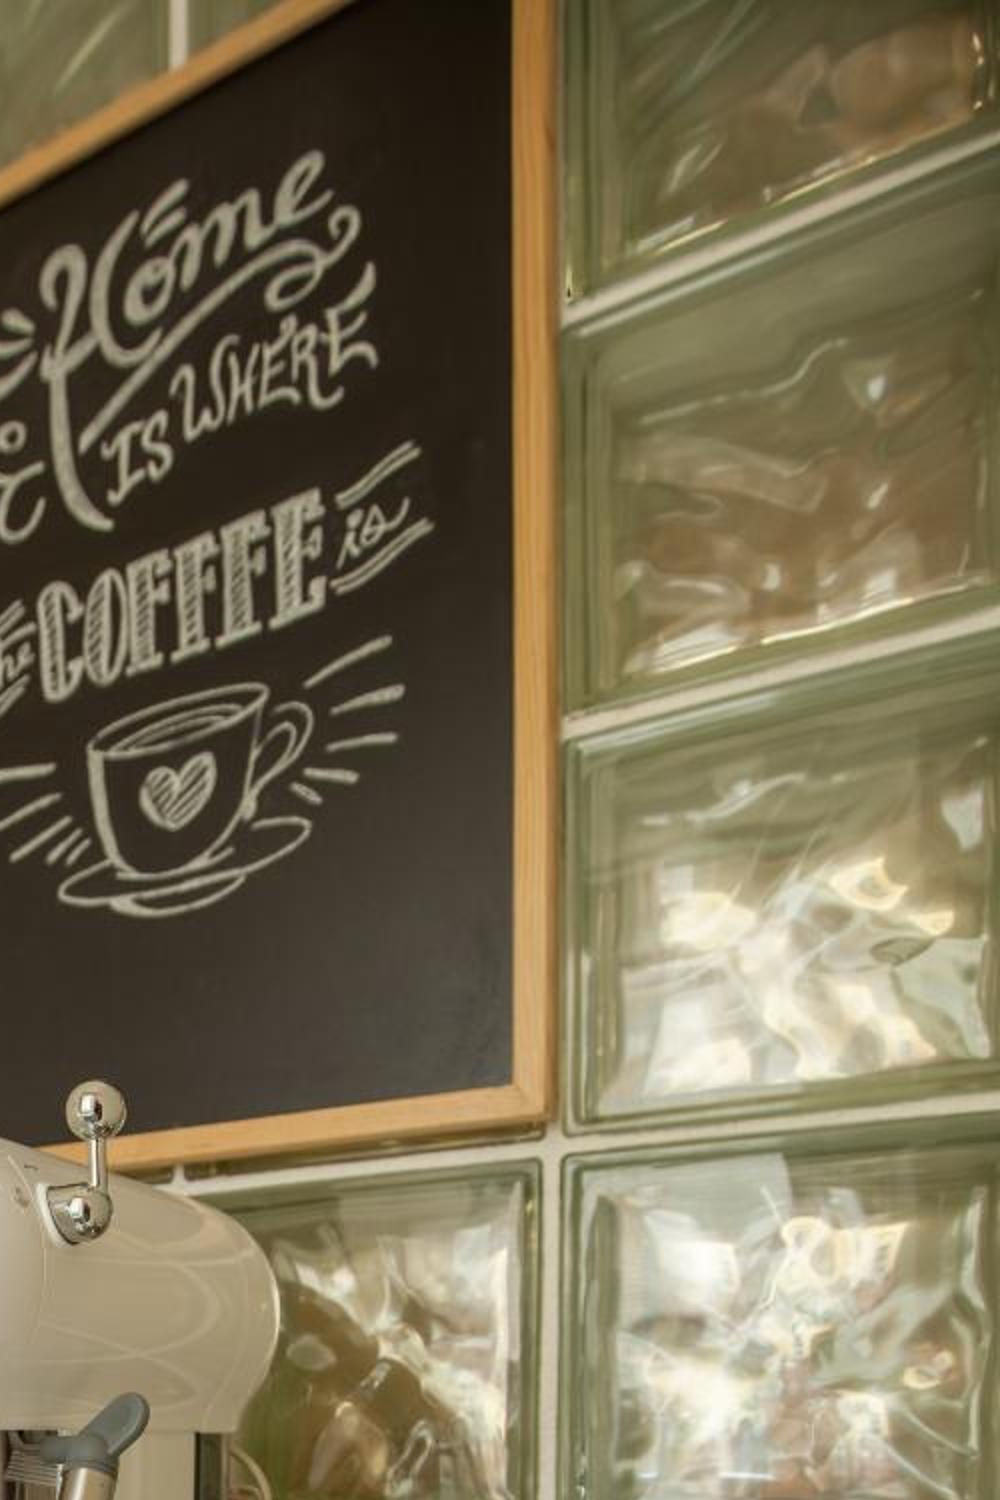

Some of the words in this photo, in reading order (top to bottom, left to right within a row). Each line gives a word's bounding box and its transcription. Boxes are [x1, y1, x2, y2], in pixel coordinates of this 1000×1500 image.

[101, 411, 174, 504] IS
[169, 261, 379, 442] WHERE
[37, 486, 328, 702] COFFEE
[336, 497, 411, 570] is
